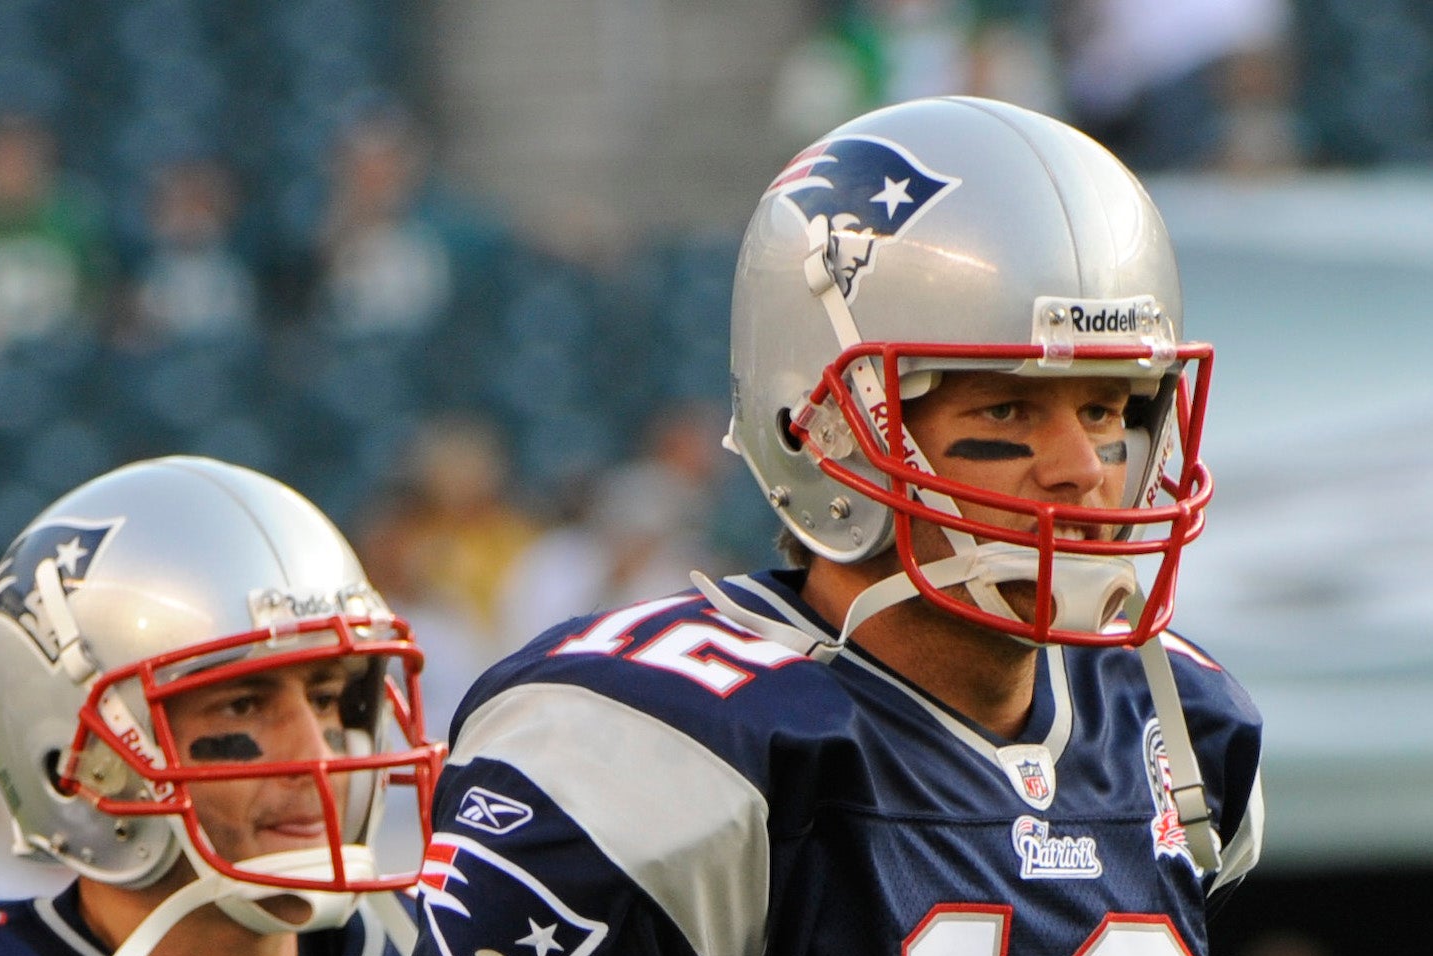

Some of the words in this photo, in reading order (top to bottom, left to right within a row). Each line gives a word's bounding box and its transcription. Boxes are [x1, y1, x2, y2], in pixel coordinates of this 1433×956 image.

[1070, 305, 1137, 333] Riddell
[546, 593, 814, 700] 12
[1020, 834, 1103, 879] Patriots
